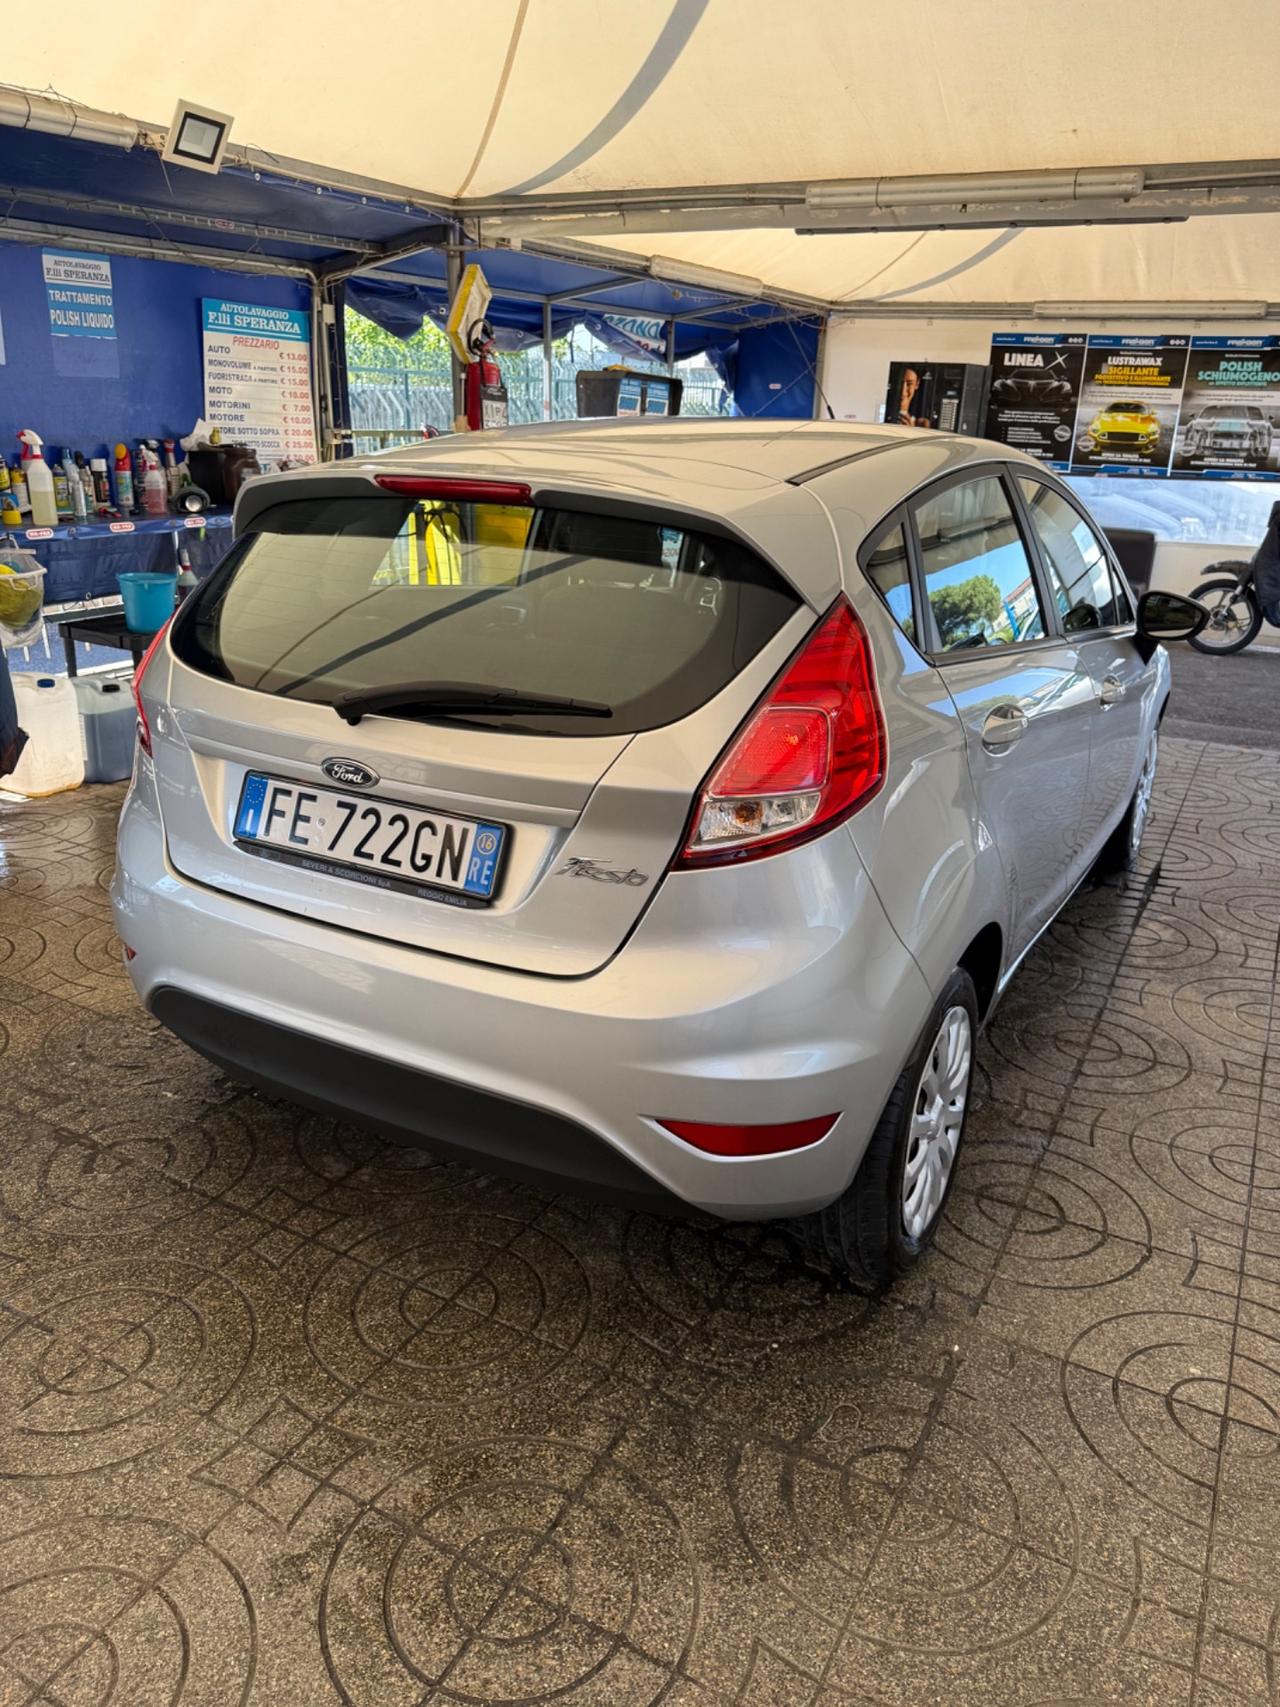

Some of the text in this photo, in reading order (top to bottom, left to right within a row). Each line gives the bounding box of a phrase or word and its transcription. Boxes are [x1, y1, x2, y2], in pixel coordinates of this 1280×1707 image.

[54, 259, 102, 271] AUTOLAVAGGIO
[63, 269, 110, 282] SPERANZA
[48, 290, 113, 306] TRATTAMENTO
[50, 309, 114, 329] POLISH LIQUIDO
[220, 303, 289, 320] AUTOLAVAGGIO
[207, 311, 301, 333] F.lli SPERANZA
[232, 336, 280, 350] PREZZARIO
[208, 345, 307, 362] AUTO € 13.00
[1003, 350, 1071, 371] LINEA X
[208, 359, 252, 370] MONOVOLUME
[286, 366, 308, 375] 15.00
[1107, 356, 1164, 367] LUSTRAWAX
[1219, 361, 1263, 372] POLISH
[1108, 366, 1160, 376] SIGILLANTE
[1197, 370, 1280, 382] SCHIUMOGENO
[208, 372, 253, 382] FUORISTRADA
[288, 378, 308, 387] 15.00
[208, 386, 233, 395] MOTO
[288, 391, 310, 399] 10.00
[209, 400, 251, 409] MOTORINI
[294, 404, 311, 413] 7.00
[209, 413, 312, 425] MOTORE € 10.00
[238, 427, 258, 435] SOTTO
[259, 427, 280, 436] SOPRA
[284, 428, 290, 436] €
[291, 429, 313, 437] 20.00
[292, 441, 313, 449] 25.00
[332, 763, 364, 784] Ford
[245, 808, 254, 832] I
[264, 786, 470, 883] FE 722GN
[479, 834, 493, 850] 16
[302, 859, 328, 874] SEVERI
[468, 856, 494, 886] RE
[555, 856, 649, 887] Fiesta
[417, 888, 467, 907] REGGIO EMILIA
